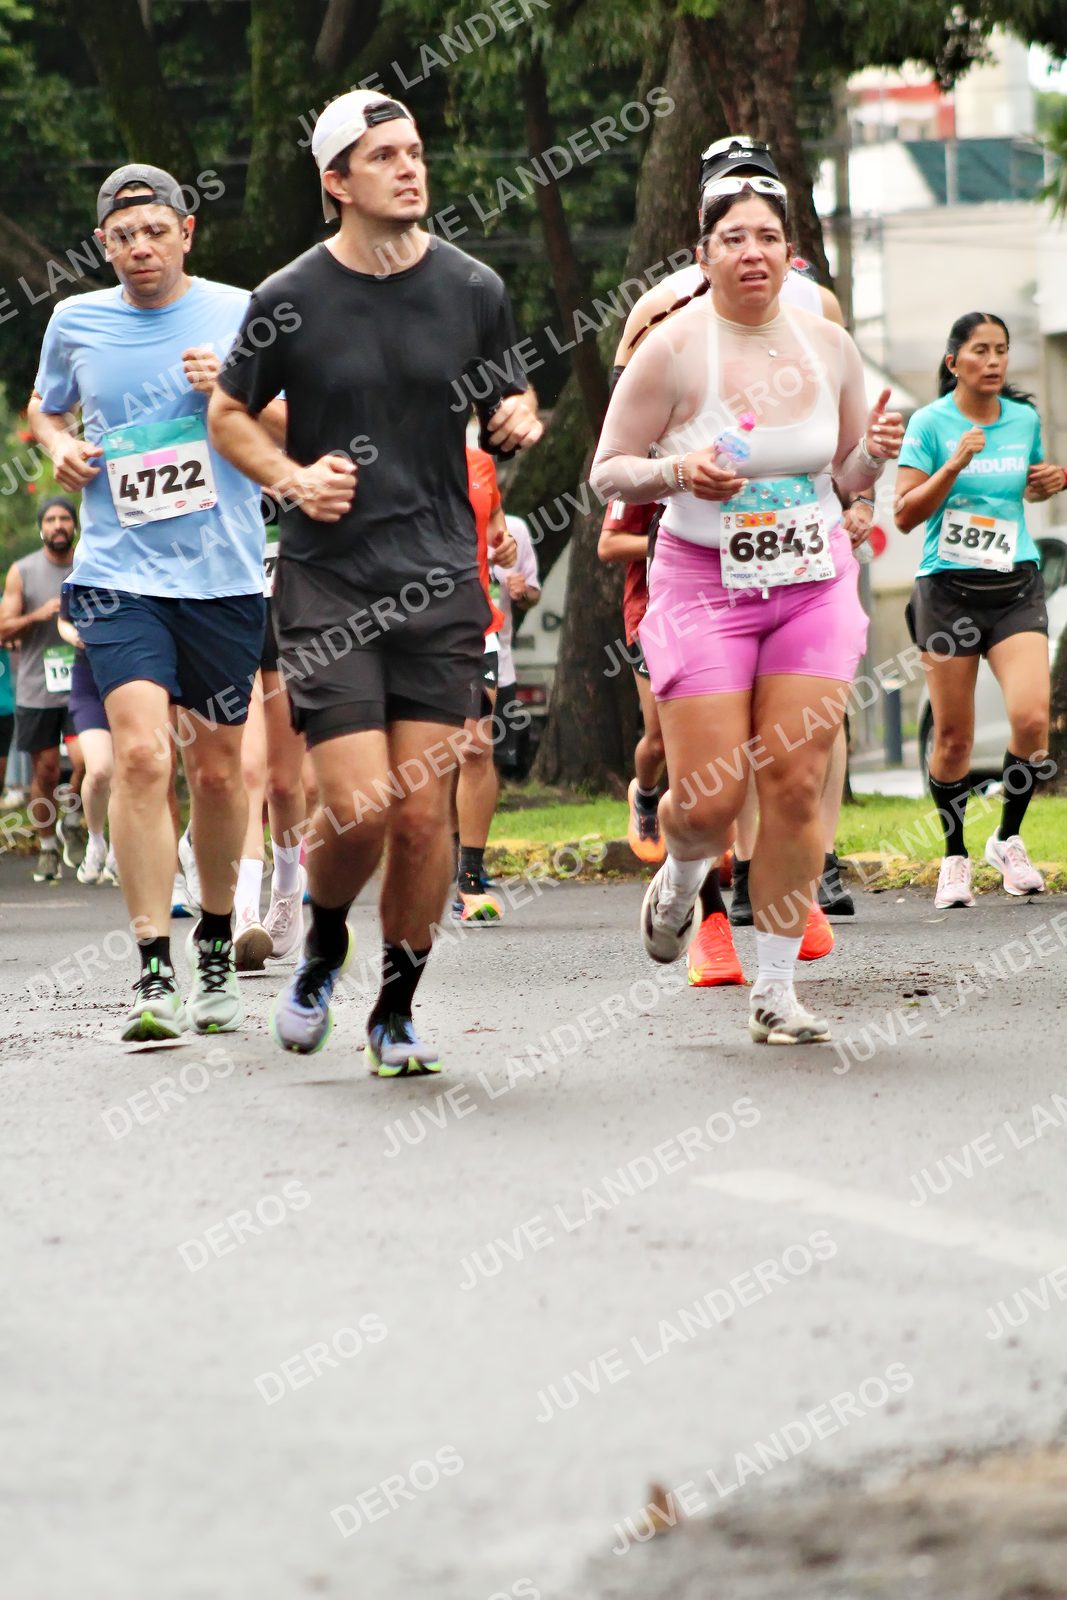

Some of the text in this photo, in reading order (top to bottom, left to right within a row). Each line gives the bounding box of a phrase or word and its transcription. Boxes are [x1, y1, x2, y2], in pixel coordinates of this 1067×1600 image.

[119, 460, 205, 501] 4722
[729, 523, 824, 562] 6843
[945, 523, 1010, 555] 3874
[52, 667, 71, 679] 19
